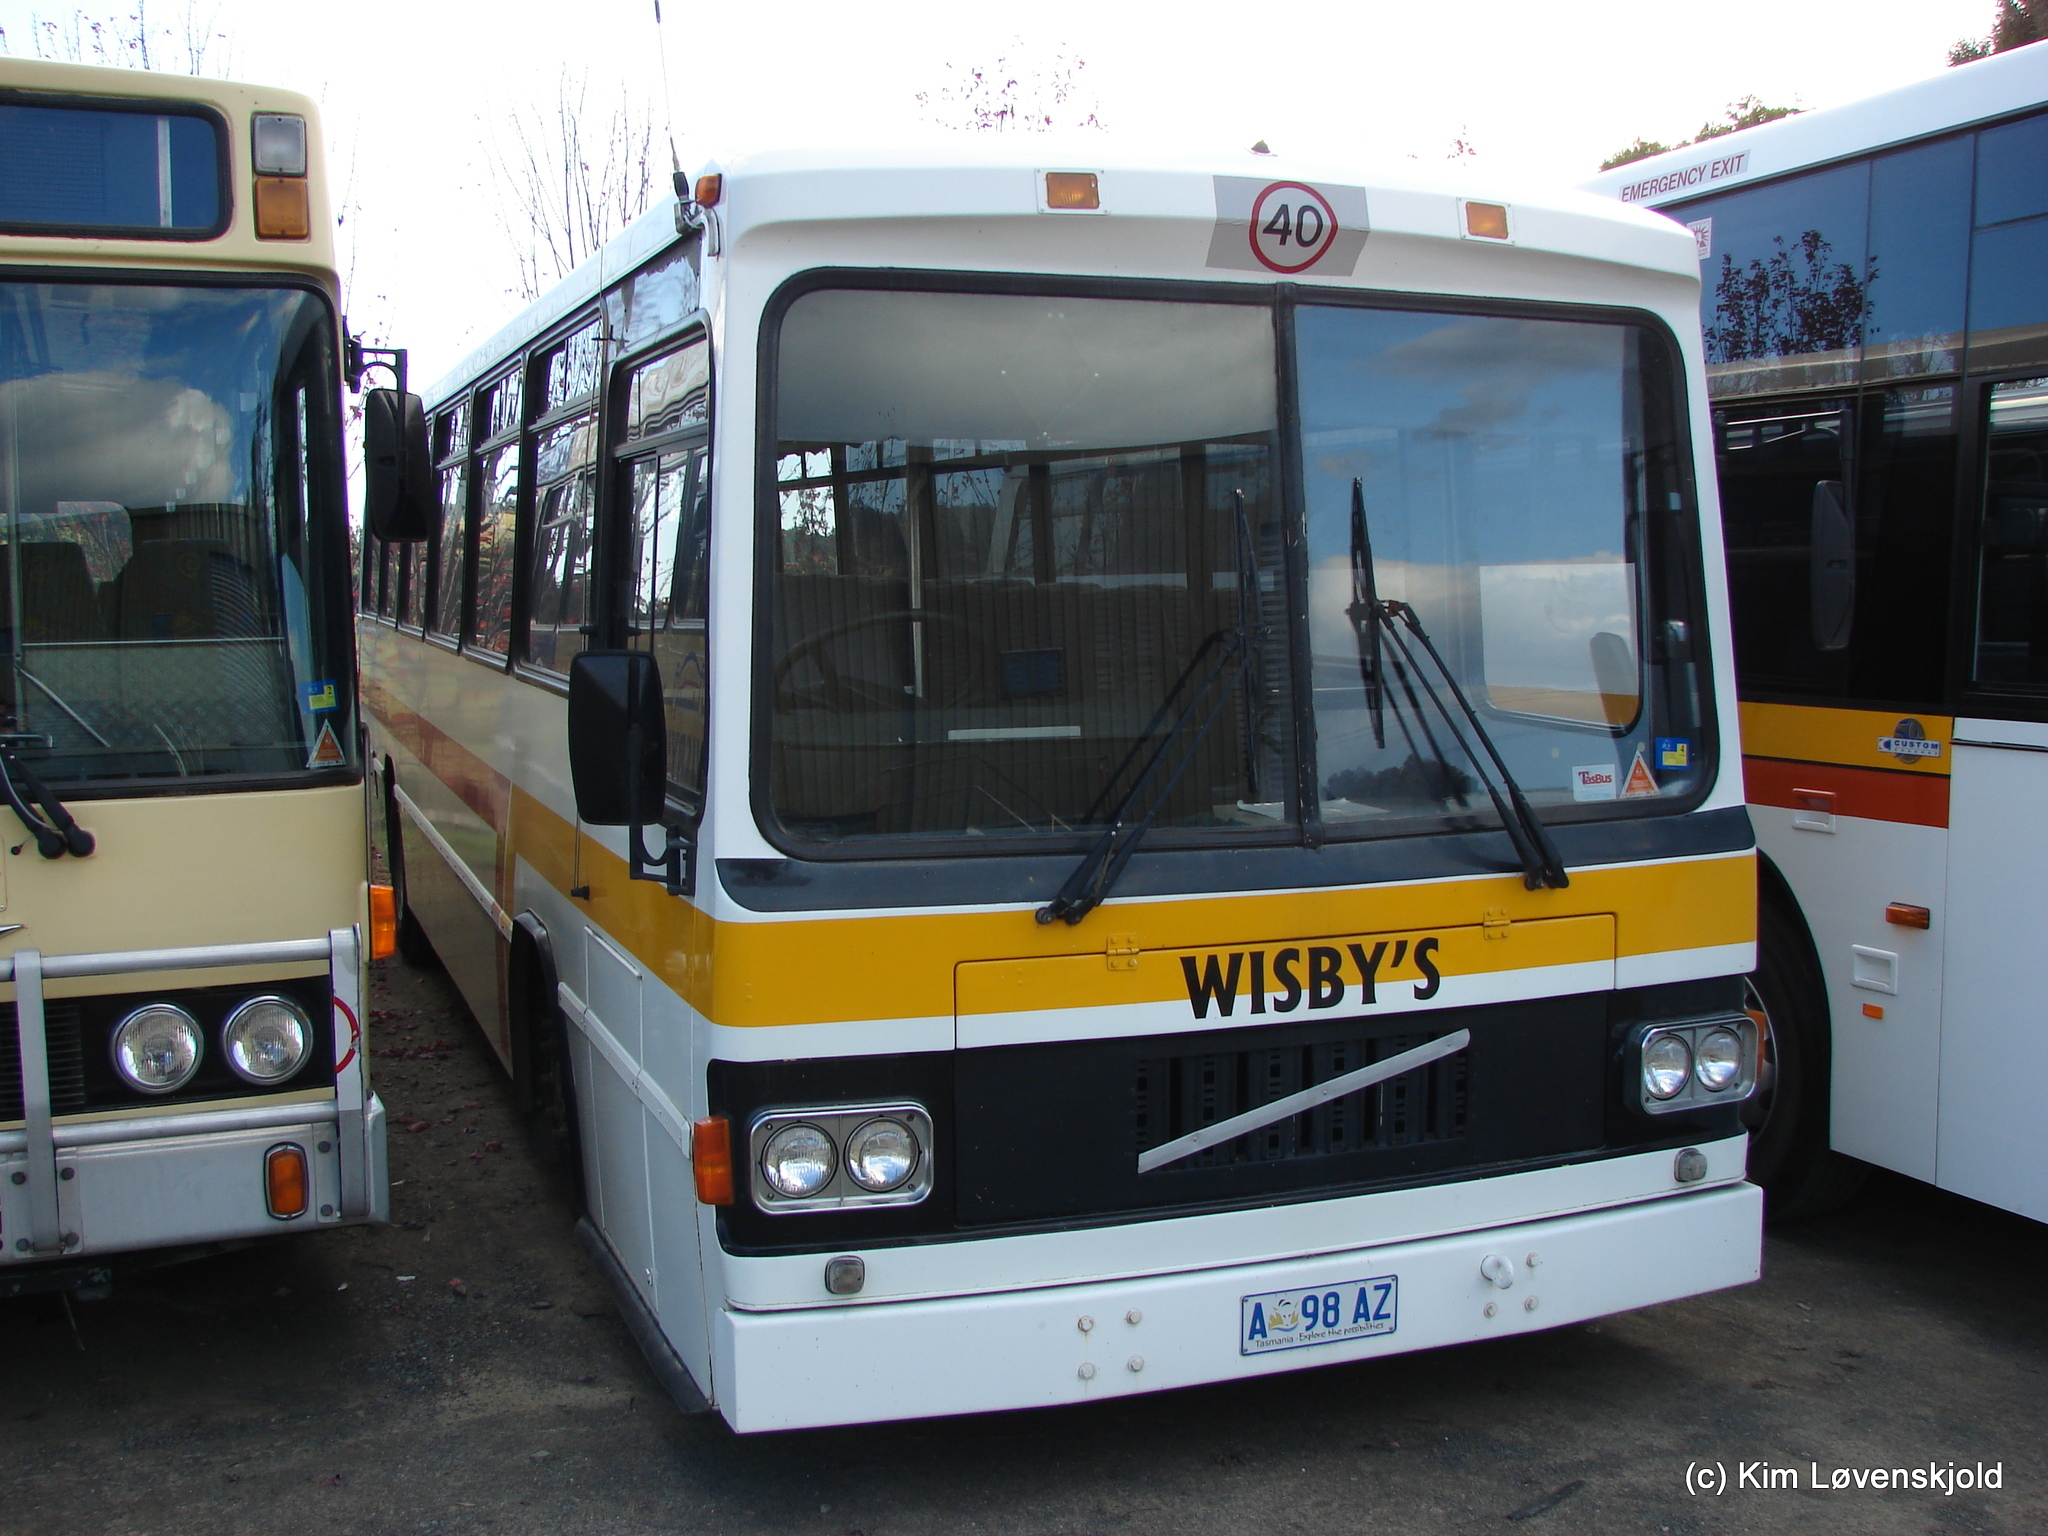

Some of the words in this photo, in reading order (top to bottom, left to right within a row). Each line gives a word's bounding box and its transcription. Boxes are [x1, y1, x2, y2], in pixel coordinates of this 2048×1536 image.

[1621, 164, 1707, 202] EMERGENCY
[1710, 154, 1745, 179] EXIT
[1262, 203, 1324, 248] 40
[1893, 739, 1938, 750] CUSTOM
[1578, 771, 1613, 785] TasBus
[1179, 937, 1441, 1019] WISBY'S
[1248, 1302, 1268, 1341] A
[1301, 1291, 1340, 1331] 98
[1352, 1283, 1392, 1324] AZ
[1255, 1335, 1294, 1348] Tasmania
[1298, 1330, 1326, 1342] Explore
[1327, 1327, 1342, 1337] the
[1343, 1322, 1384, 1335] possibilities
